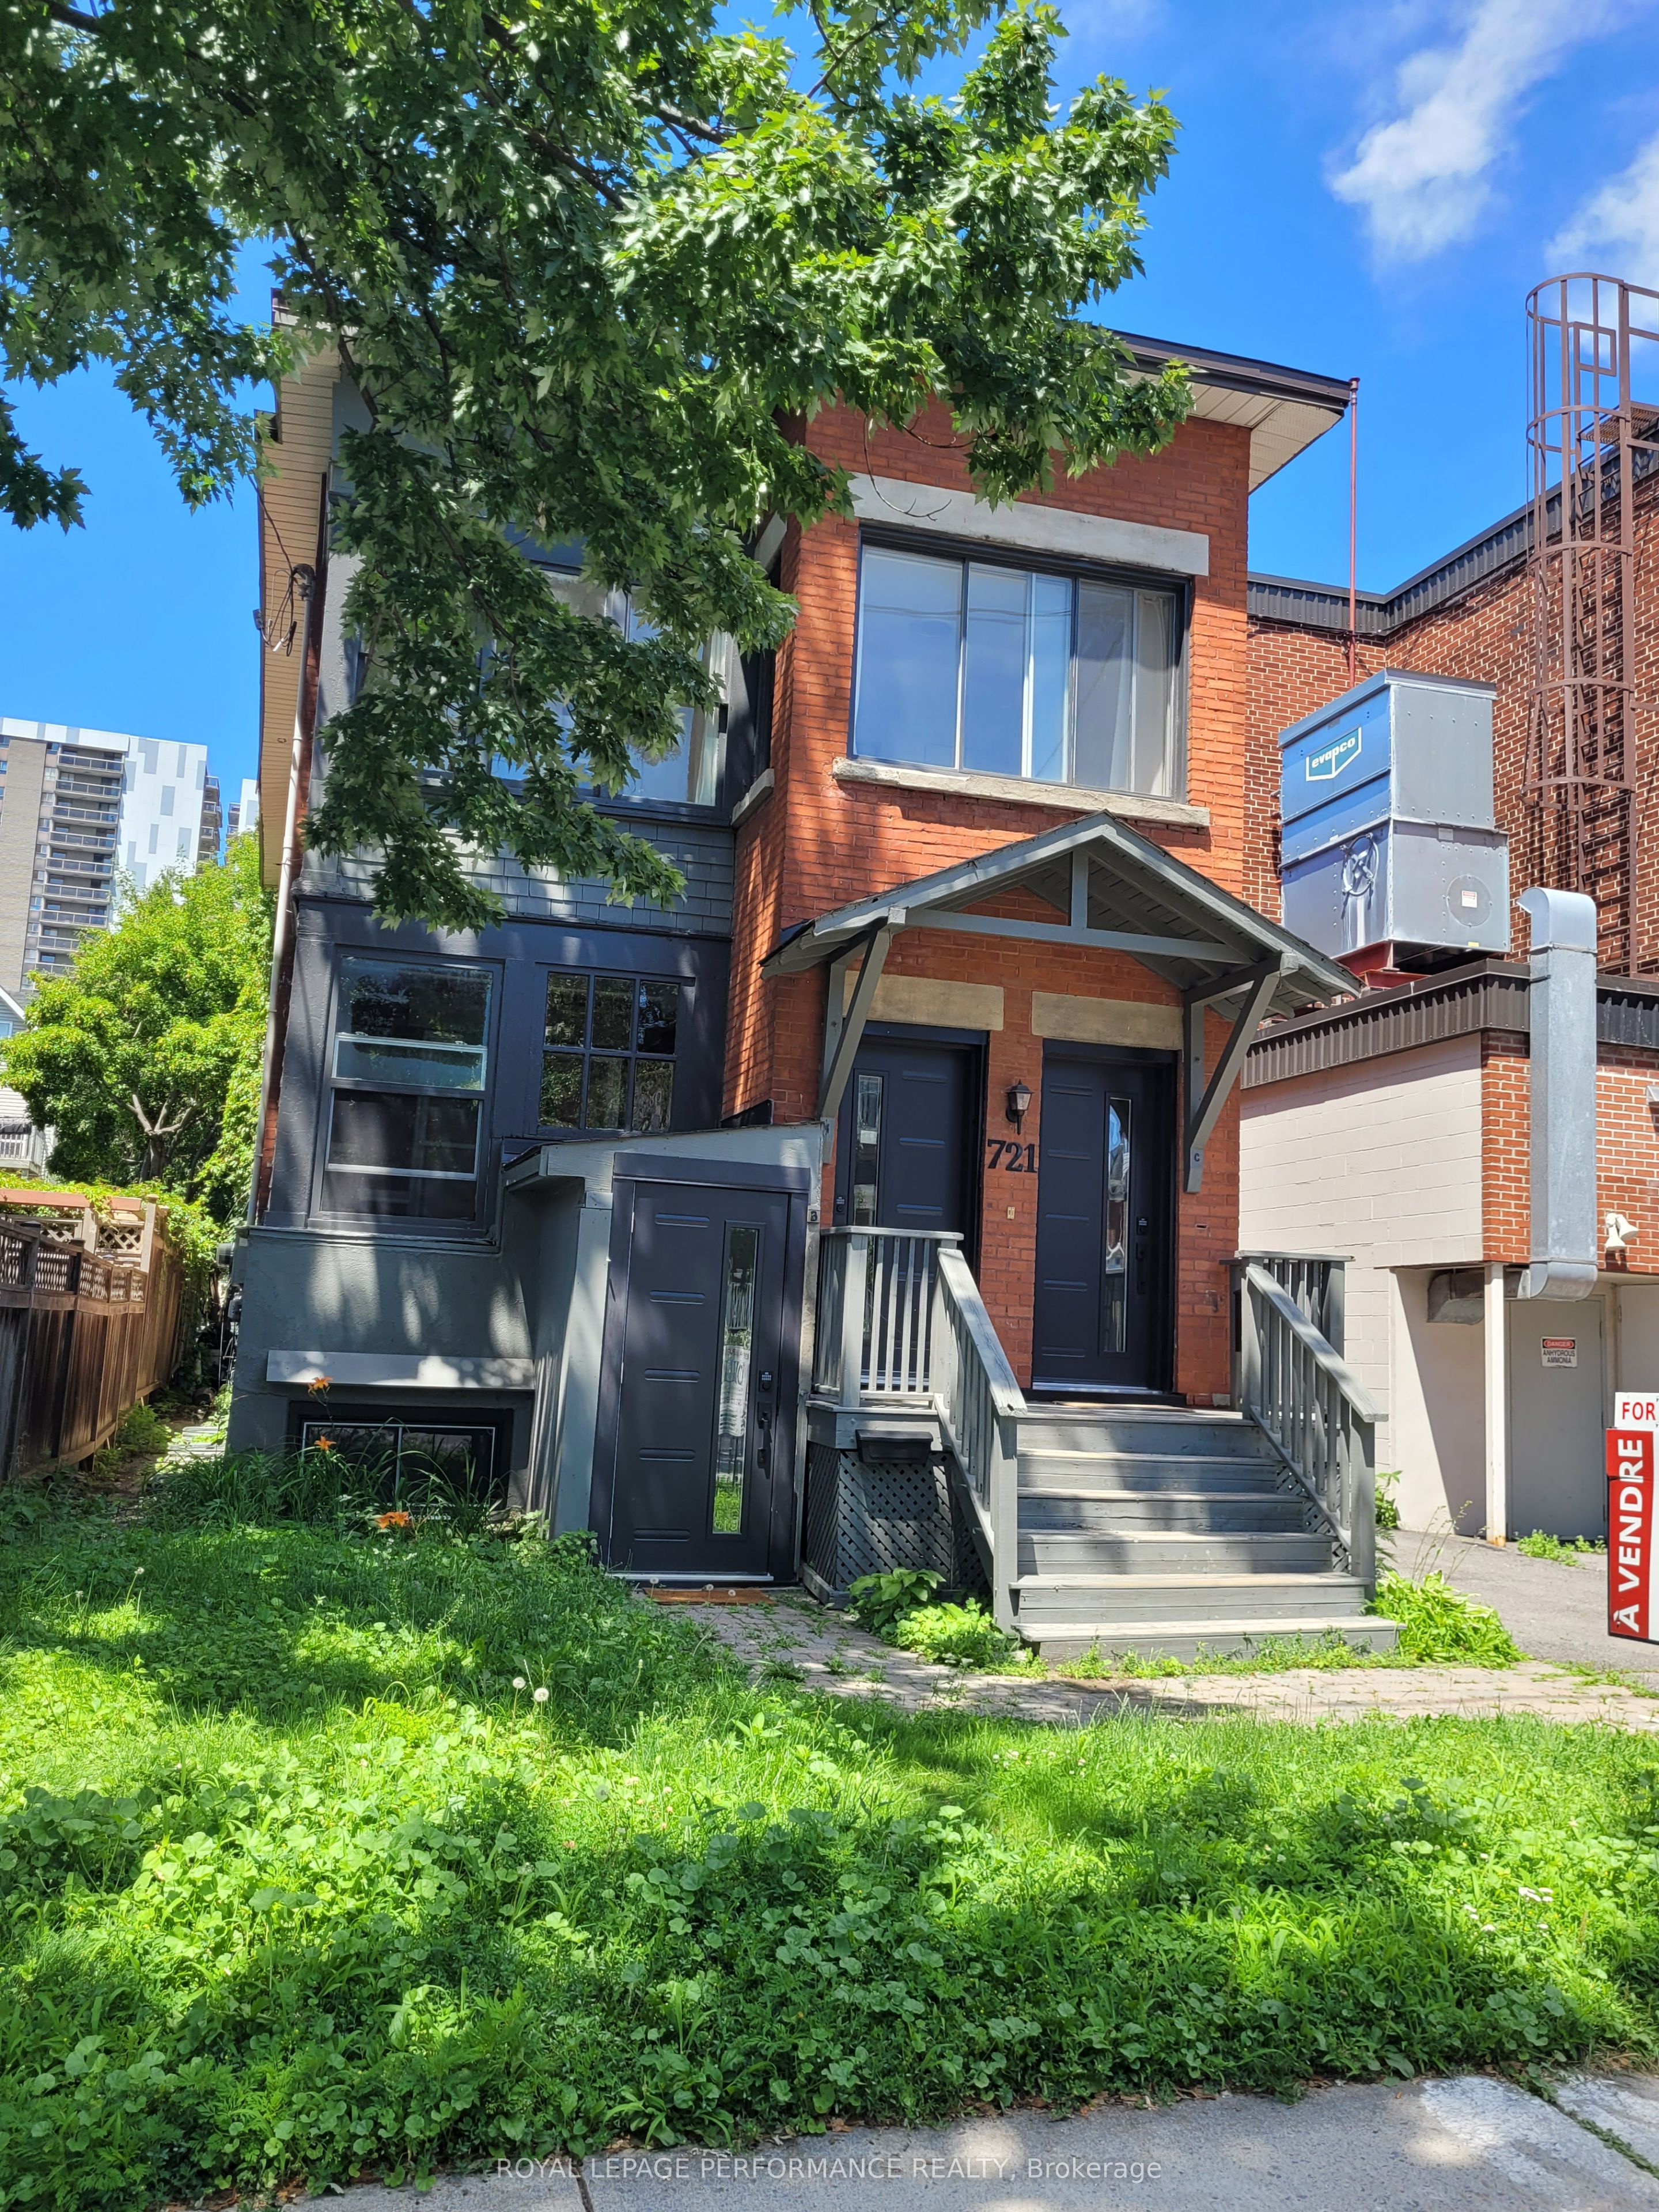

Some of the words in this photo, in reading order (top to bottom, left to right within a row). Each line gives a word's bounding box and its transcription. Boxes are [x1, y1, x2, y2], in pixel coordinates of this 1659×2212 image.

[1312, 737, 1355, 768] evapco
[987, 1139, 1037, 1172] 721
[1194, 1153, 1200, 1162] C
[1622, 1402, 1656, 1421] FOR
[1618, 1439, 1643, 1593] VENDRE
